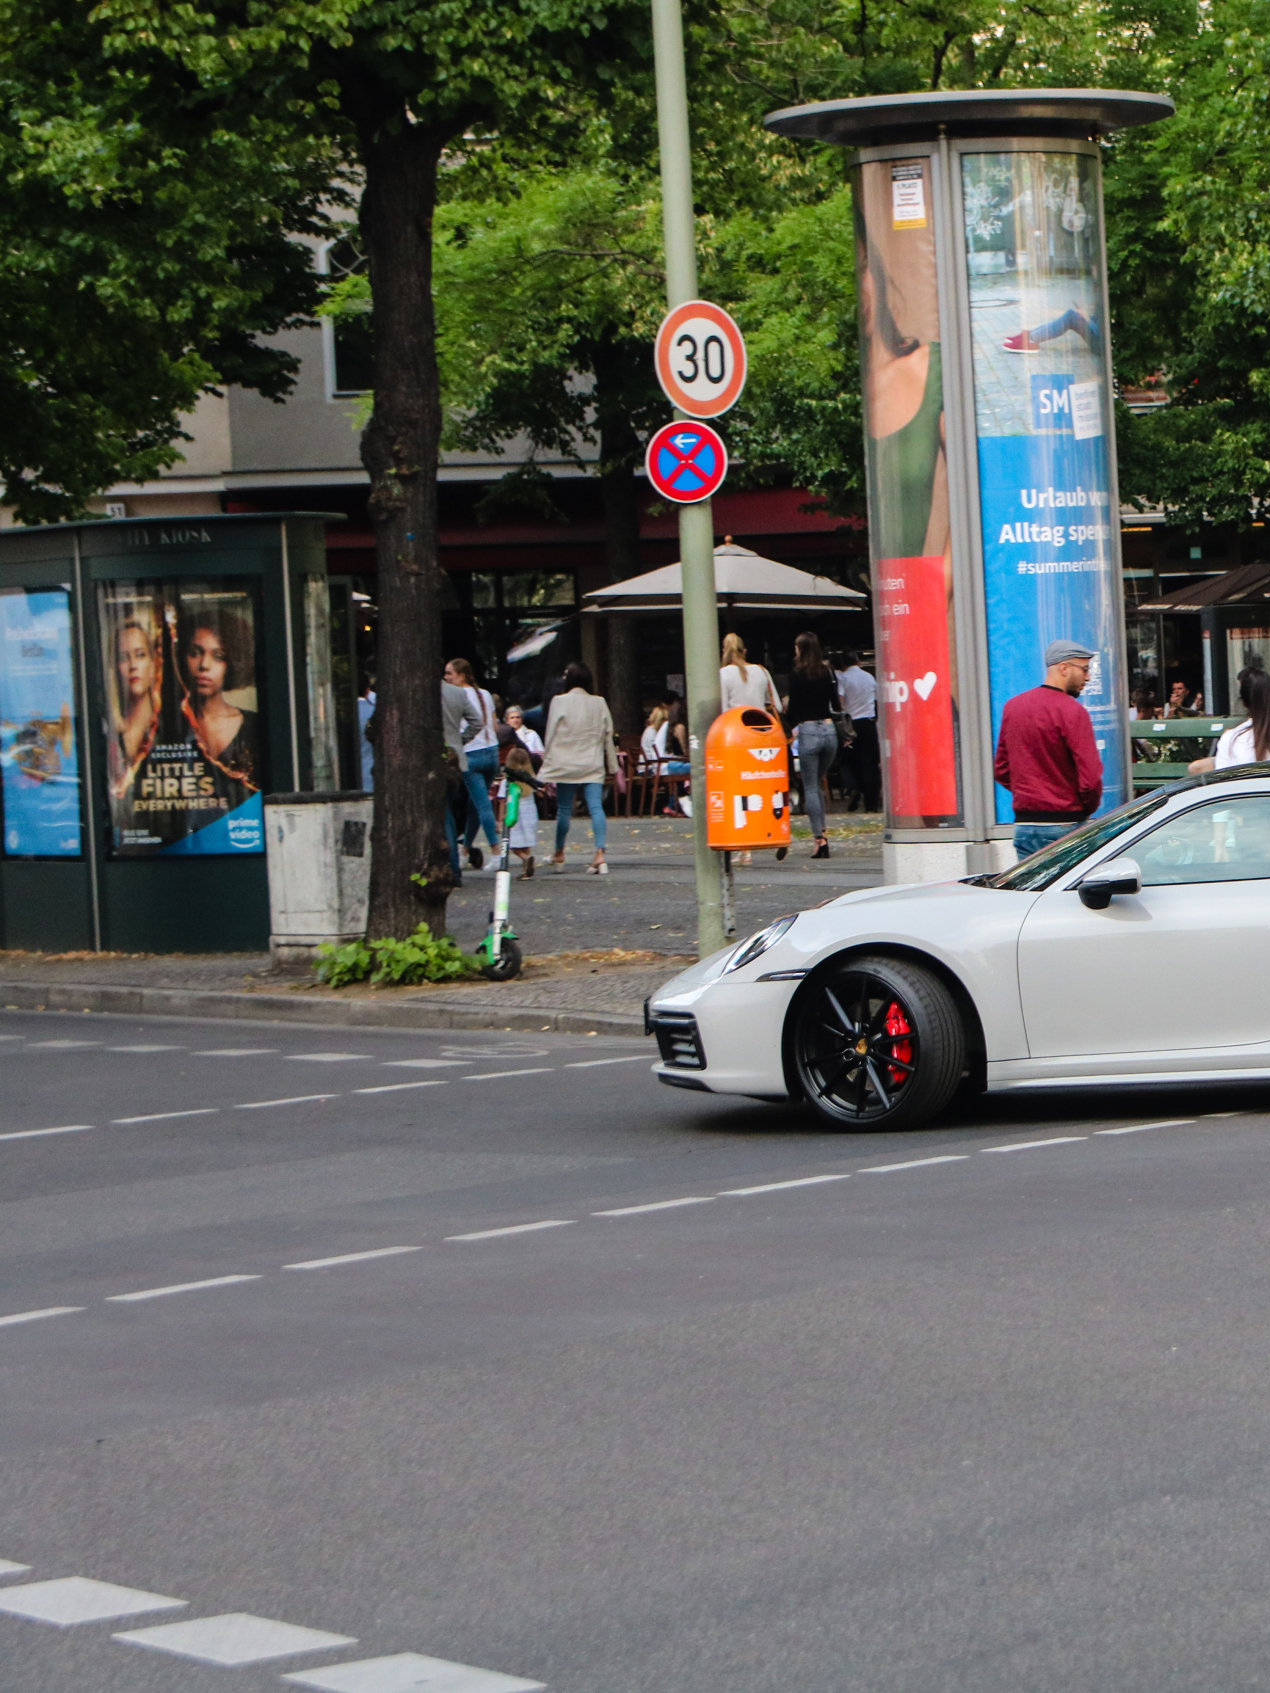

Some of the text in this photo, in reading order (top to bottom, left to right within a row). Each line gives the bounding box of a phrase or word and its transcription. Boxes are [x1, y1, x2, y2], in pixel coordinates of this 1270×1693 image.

[676, 334, 725, 384] 30
[1020, 486, 1086, 509] Urlaub
[998, 521, 1066, 547] Alltag
[892, 600, 910, 616] ein
[147, 762, 205, 778] LITTLE
[141, 776, 215, 798] FIRES
[133, 797, 229, 812] EVERYWHERE
[228, 817, 260, 829] prime
[229, 829, 261, 840] video
